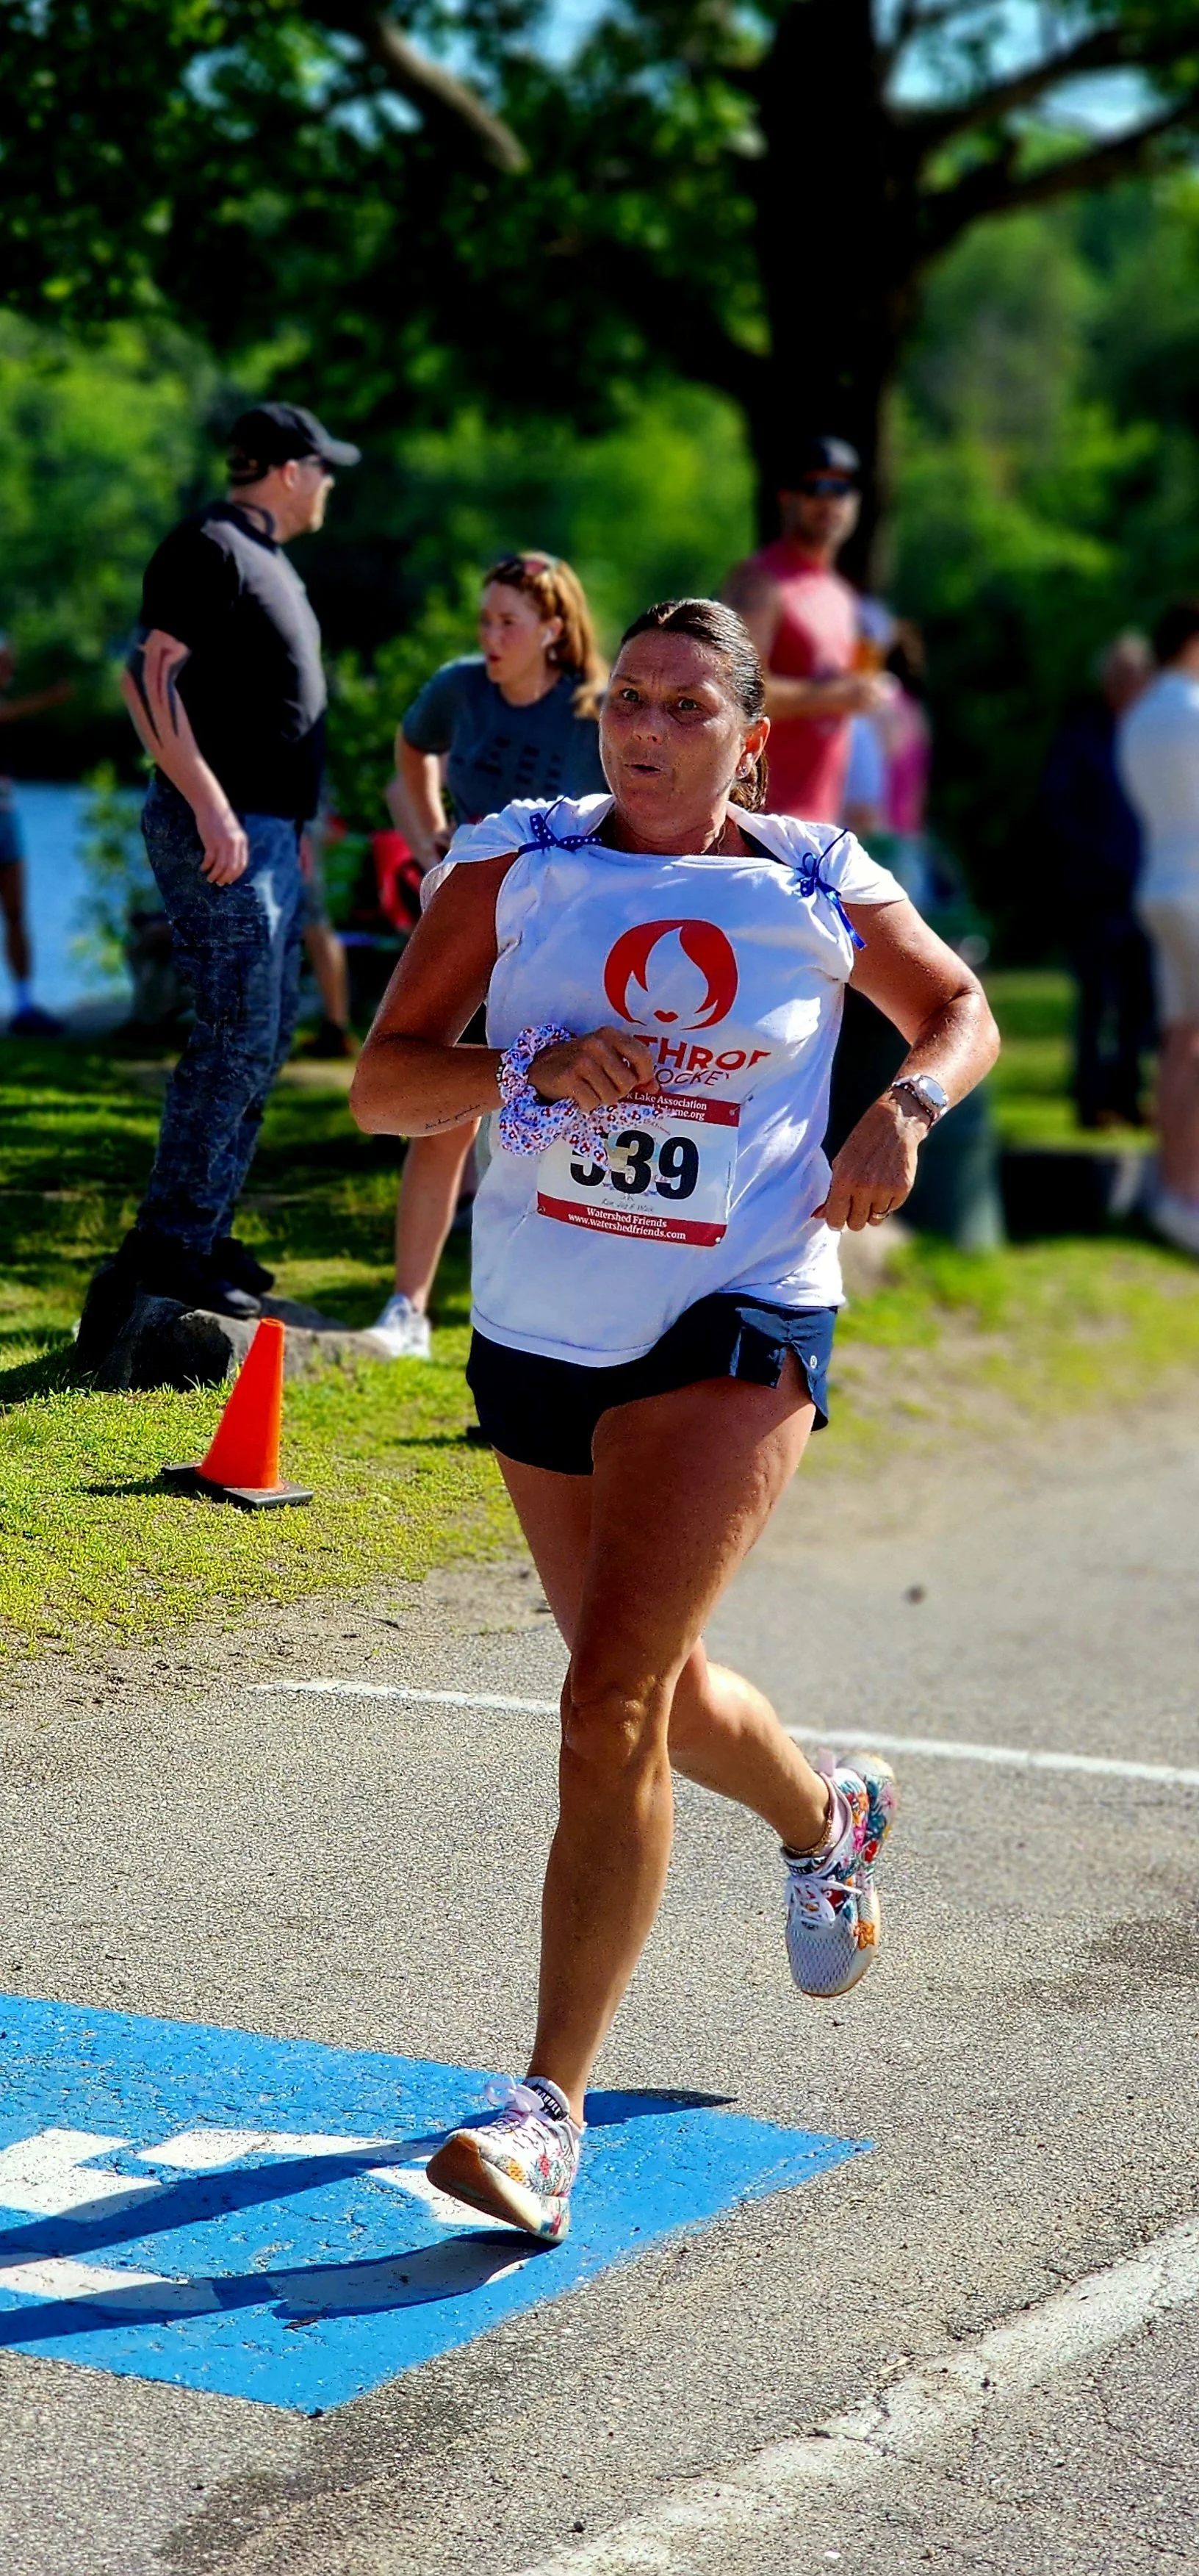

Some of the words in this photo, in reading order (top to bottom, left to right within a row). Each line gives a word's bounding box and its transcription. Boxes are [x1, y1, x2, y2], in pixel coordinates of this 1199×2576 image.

[653, 1066, 729, 1086] OCKE
[635, 1092, 656, 1104] Lake
[656, 1095, 707, 1111] Association
[570, 1129, 699, 1199] 539
[568, 1213, 686, 1240] www.watershedfriends.com
[586, 1207, 631, 1224] Watershed
[633, 1215, 667, 1227] Friends
